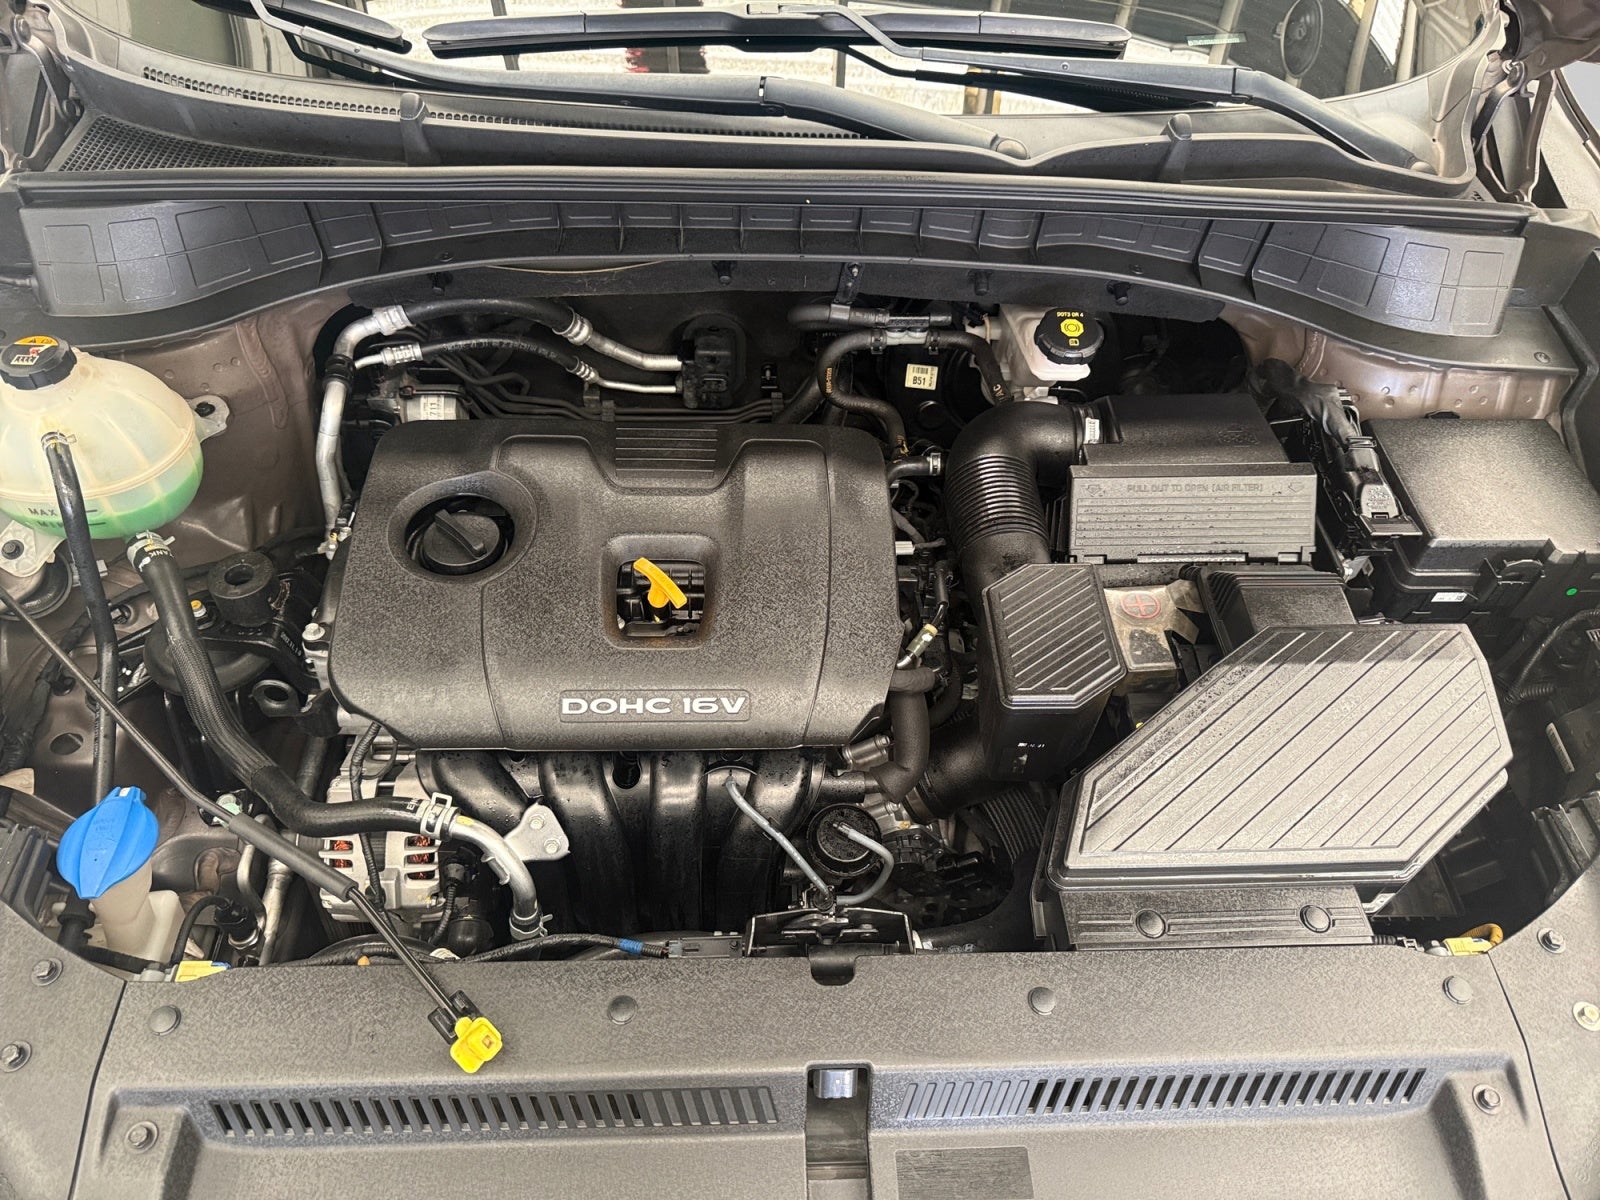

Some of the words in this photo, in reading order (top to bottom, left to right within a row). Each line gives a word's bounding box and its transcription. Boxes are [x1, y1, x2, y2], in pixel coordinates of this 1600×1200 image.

[912, 375, 926, 386] B51
[1127, 484, 1150, 493] PULL
[1151, 484, 1169, 493] OUT
[1170, 484, 1182, 492] TO
[1184, 483, 1209, 492] OPEN
[28, 507, 57, 516] MAX
[562, 697, 672, 714] DOHC
[682, 697, 746, 714] 16V
